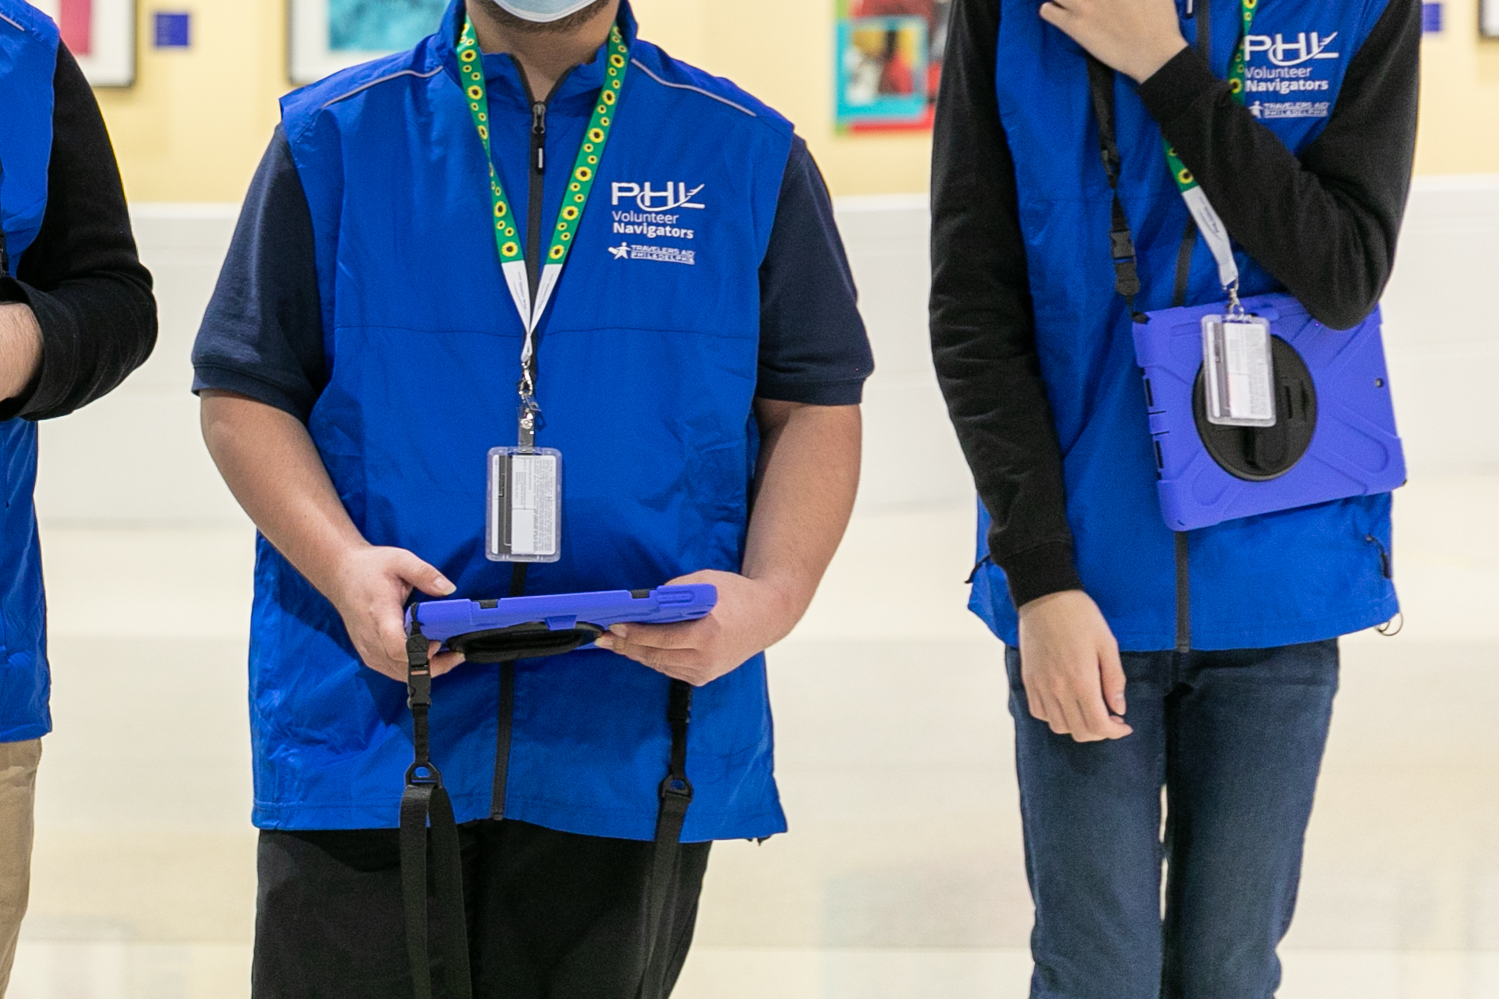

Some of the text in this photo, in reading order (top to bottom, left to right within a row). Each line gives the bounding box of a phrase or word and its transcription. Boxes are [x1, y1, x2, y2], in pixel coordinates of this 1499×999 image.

[1244, 31, 1339, 67] PHL
[1245, 66, 1313, 78] Volunteer
[1245, 78, 1329, 95] Navigators
[1263, 102, 1312, 110] TRAVELERS
[611, 181, 706, 211] PHL
[612, 210, 680, 224] Volunteer
[613, 222, 694, 239] Navigators
[630, 245, 696, 258] TRAVELERS AID
